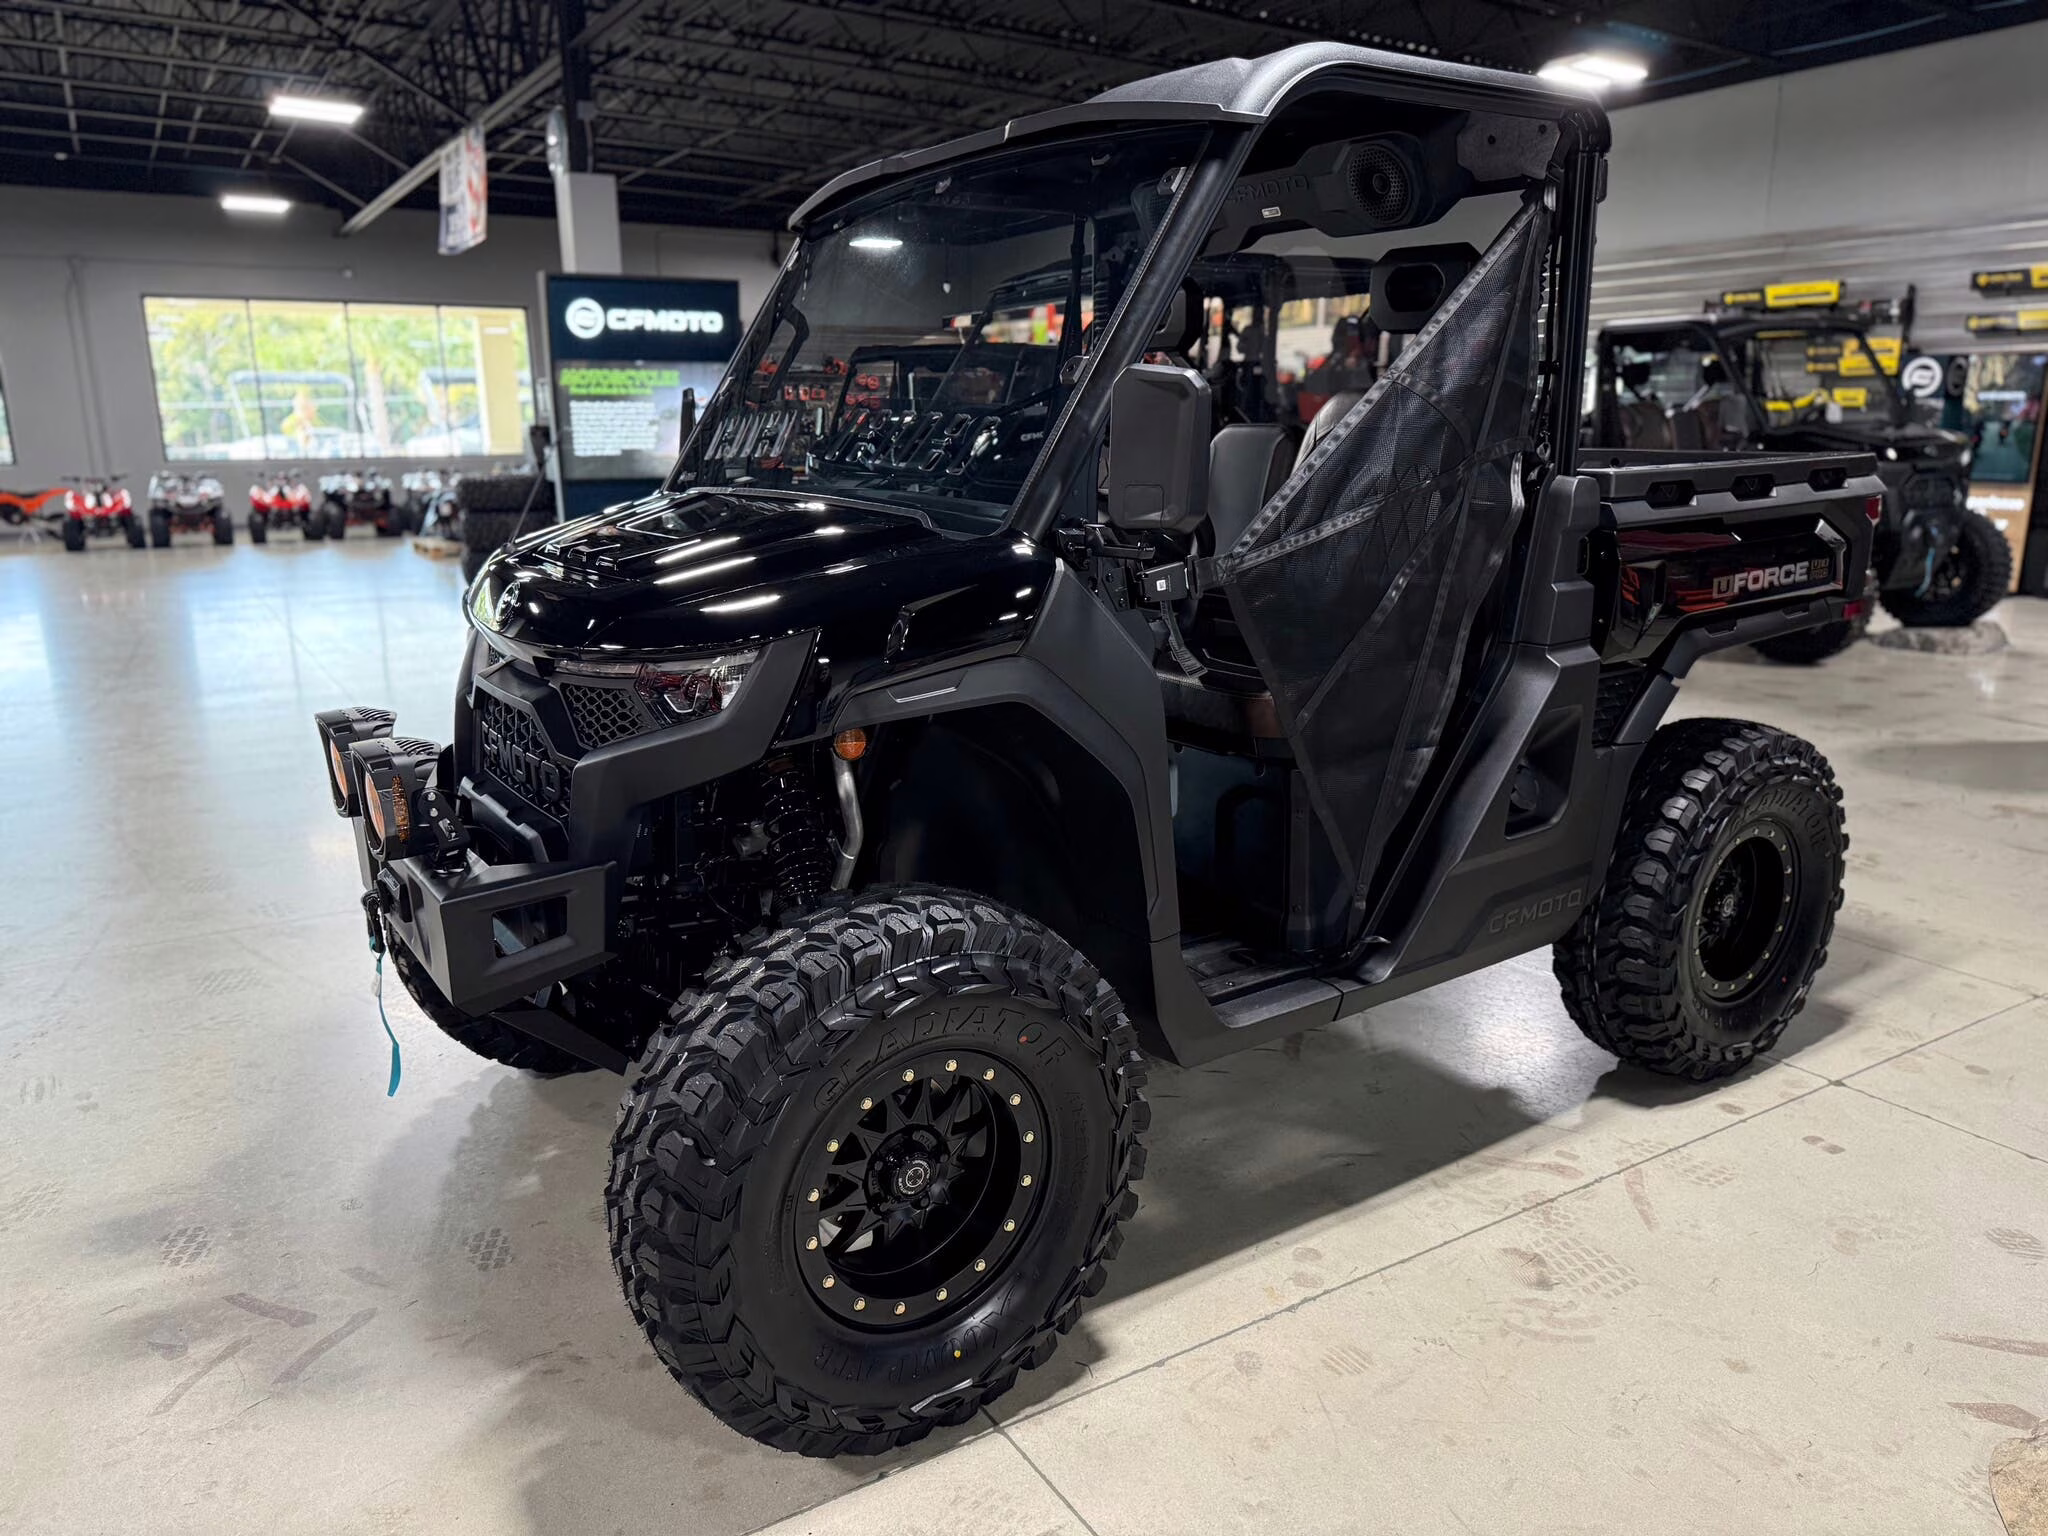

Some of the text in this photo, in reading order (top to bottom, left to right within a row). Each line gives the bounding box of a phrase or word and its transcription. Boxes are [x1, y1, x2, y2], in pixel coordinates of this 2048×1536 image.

[606, 308, 724, 333] CFMOTO
[1712, 560, 1810, 600] UFORCE
[481, 720, 561, 803] CFMOTO
[1489, 887, 1582, 934] CFMOTO
[814, 1005, 1073, 1113] GLADIATOR
